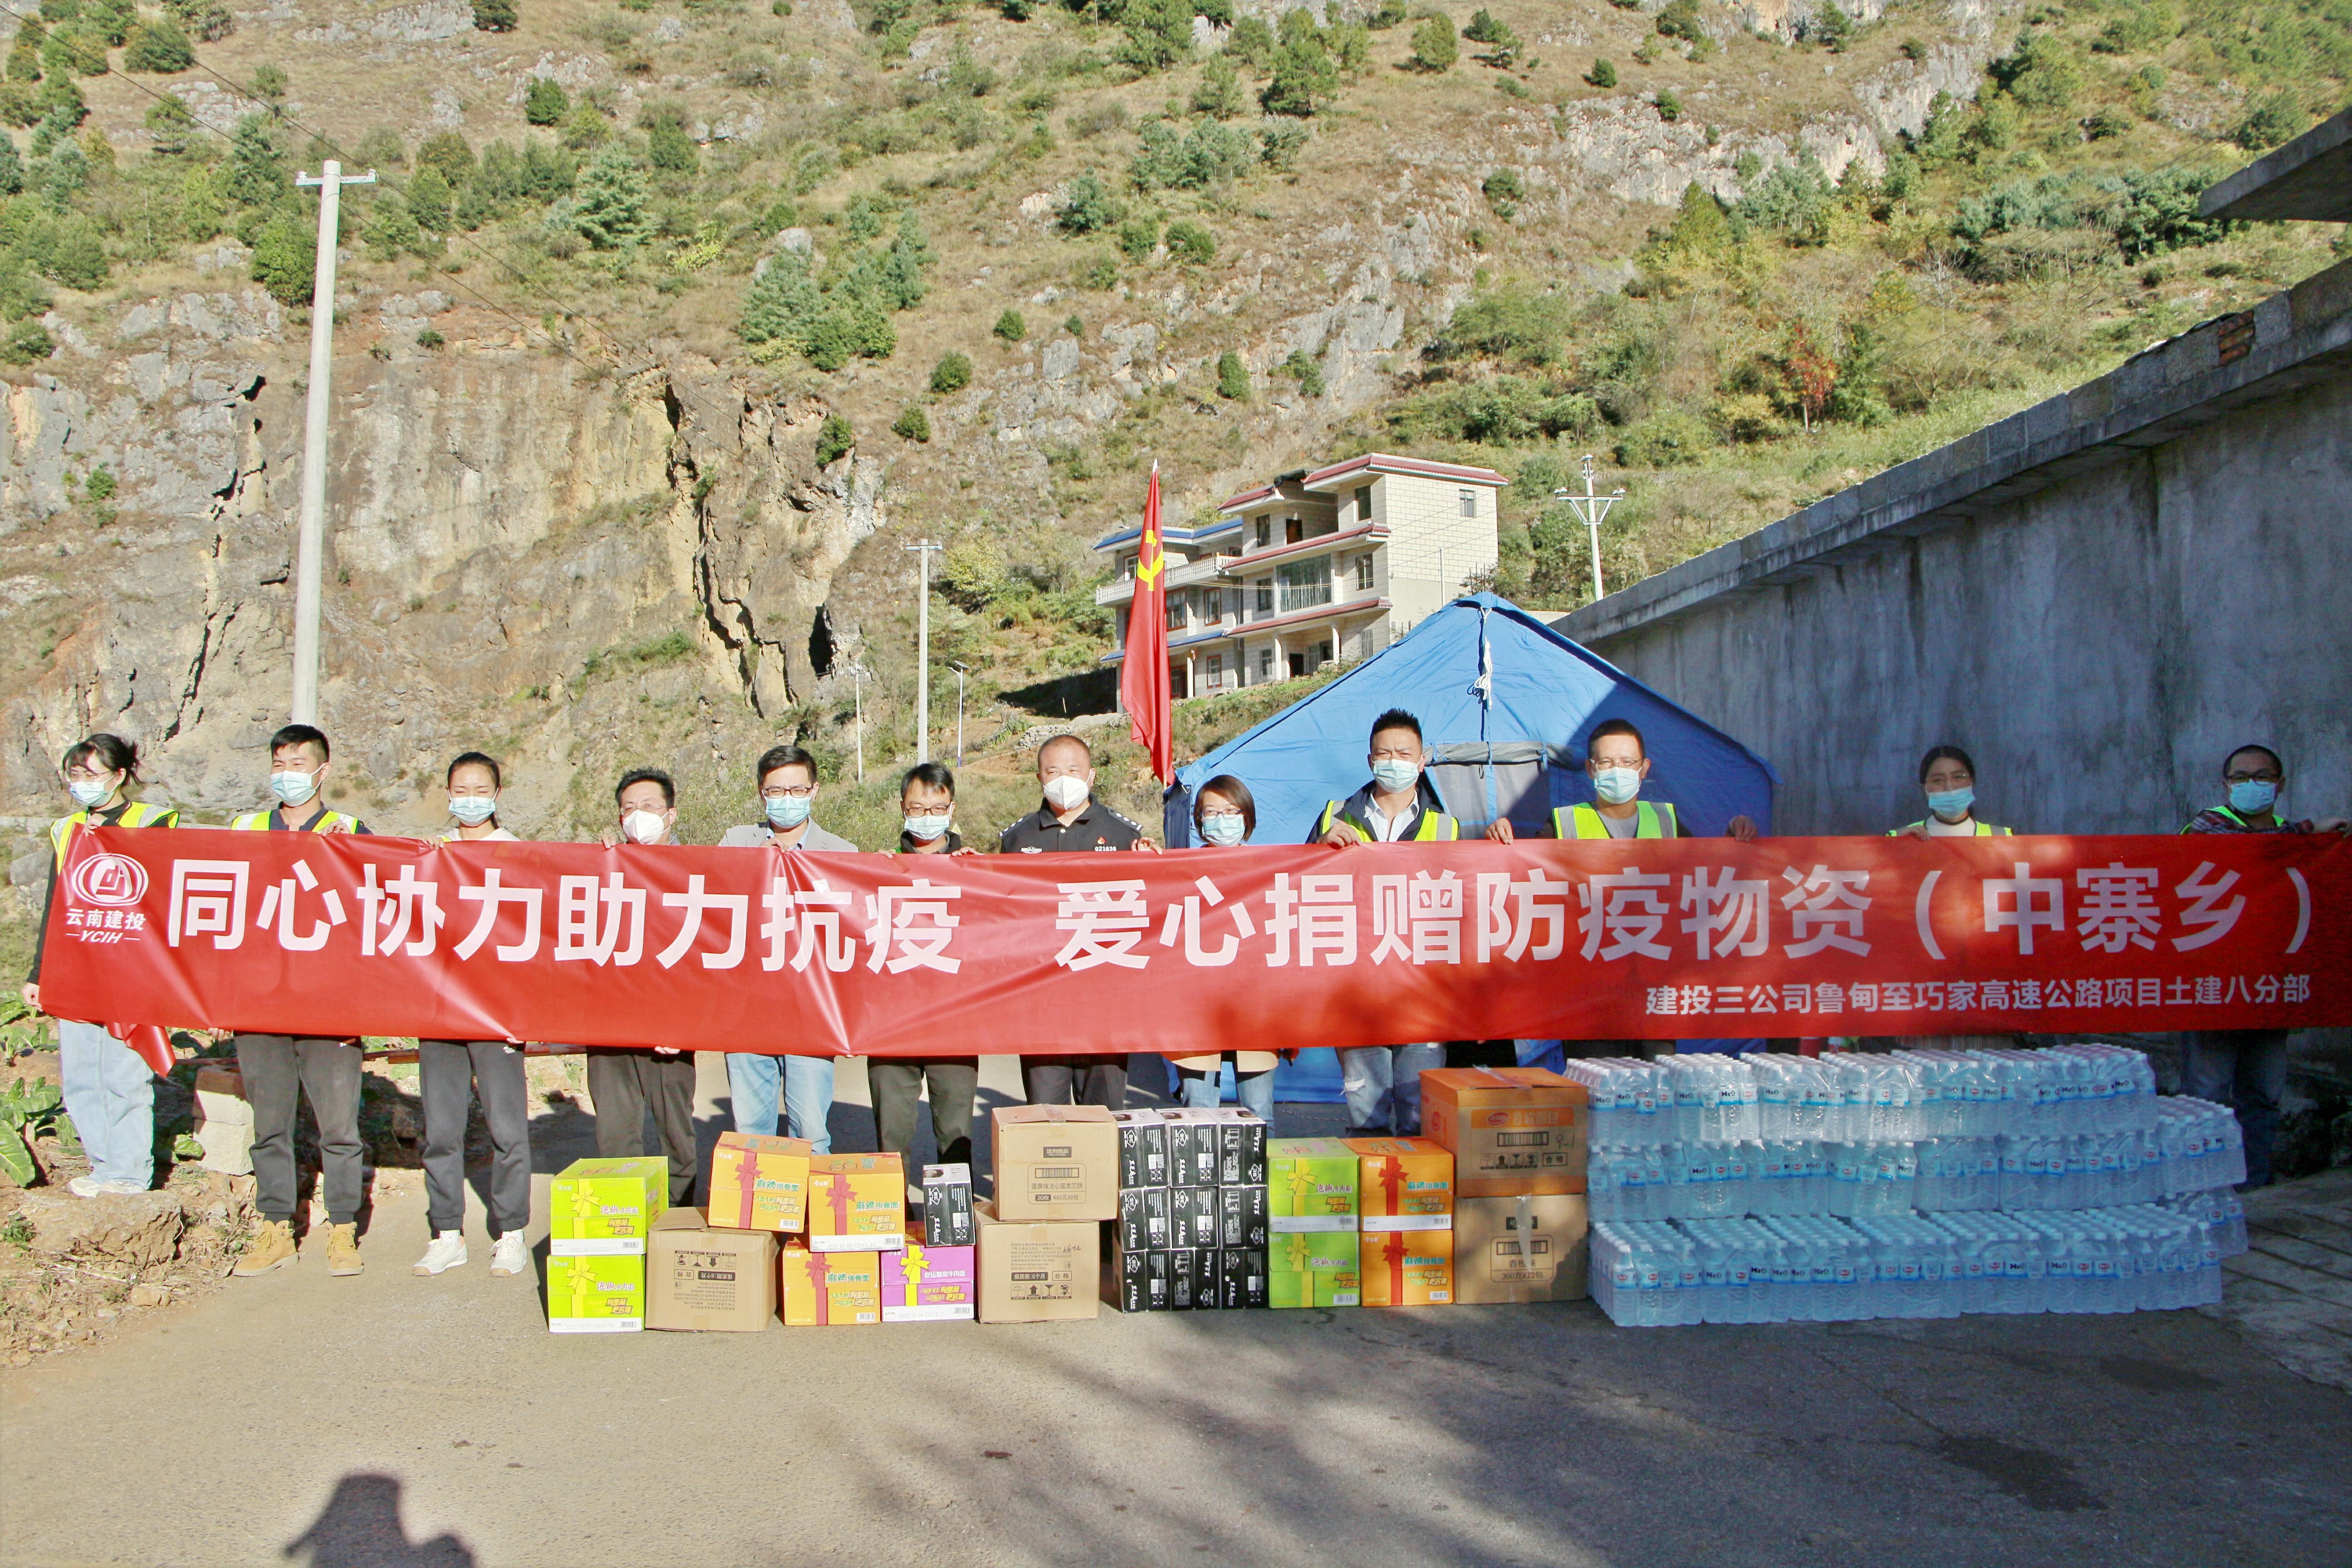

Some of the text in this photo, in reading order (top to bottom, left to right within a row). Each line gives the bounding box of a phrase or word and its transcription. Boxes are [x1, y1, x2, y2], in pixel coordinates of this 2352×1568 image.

[67, 907, 147, 931] 云南建投
[168, 858, 962, 975] 同心协力助力抗疫
[80, 930, 123, 944] YCIH
[1645, 973, 2311, 1015] 建投三公司鲁甸至巧家高速公路项目土建八分部
[924, 1270, 966, 1278] 老坛酸菜牛肉面
